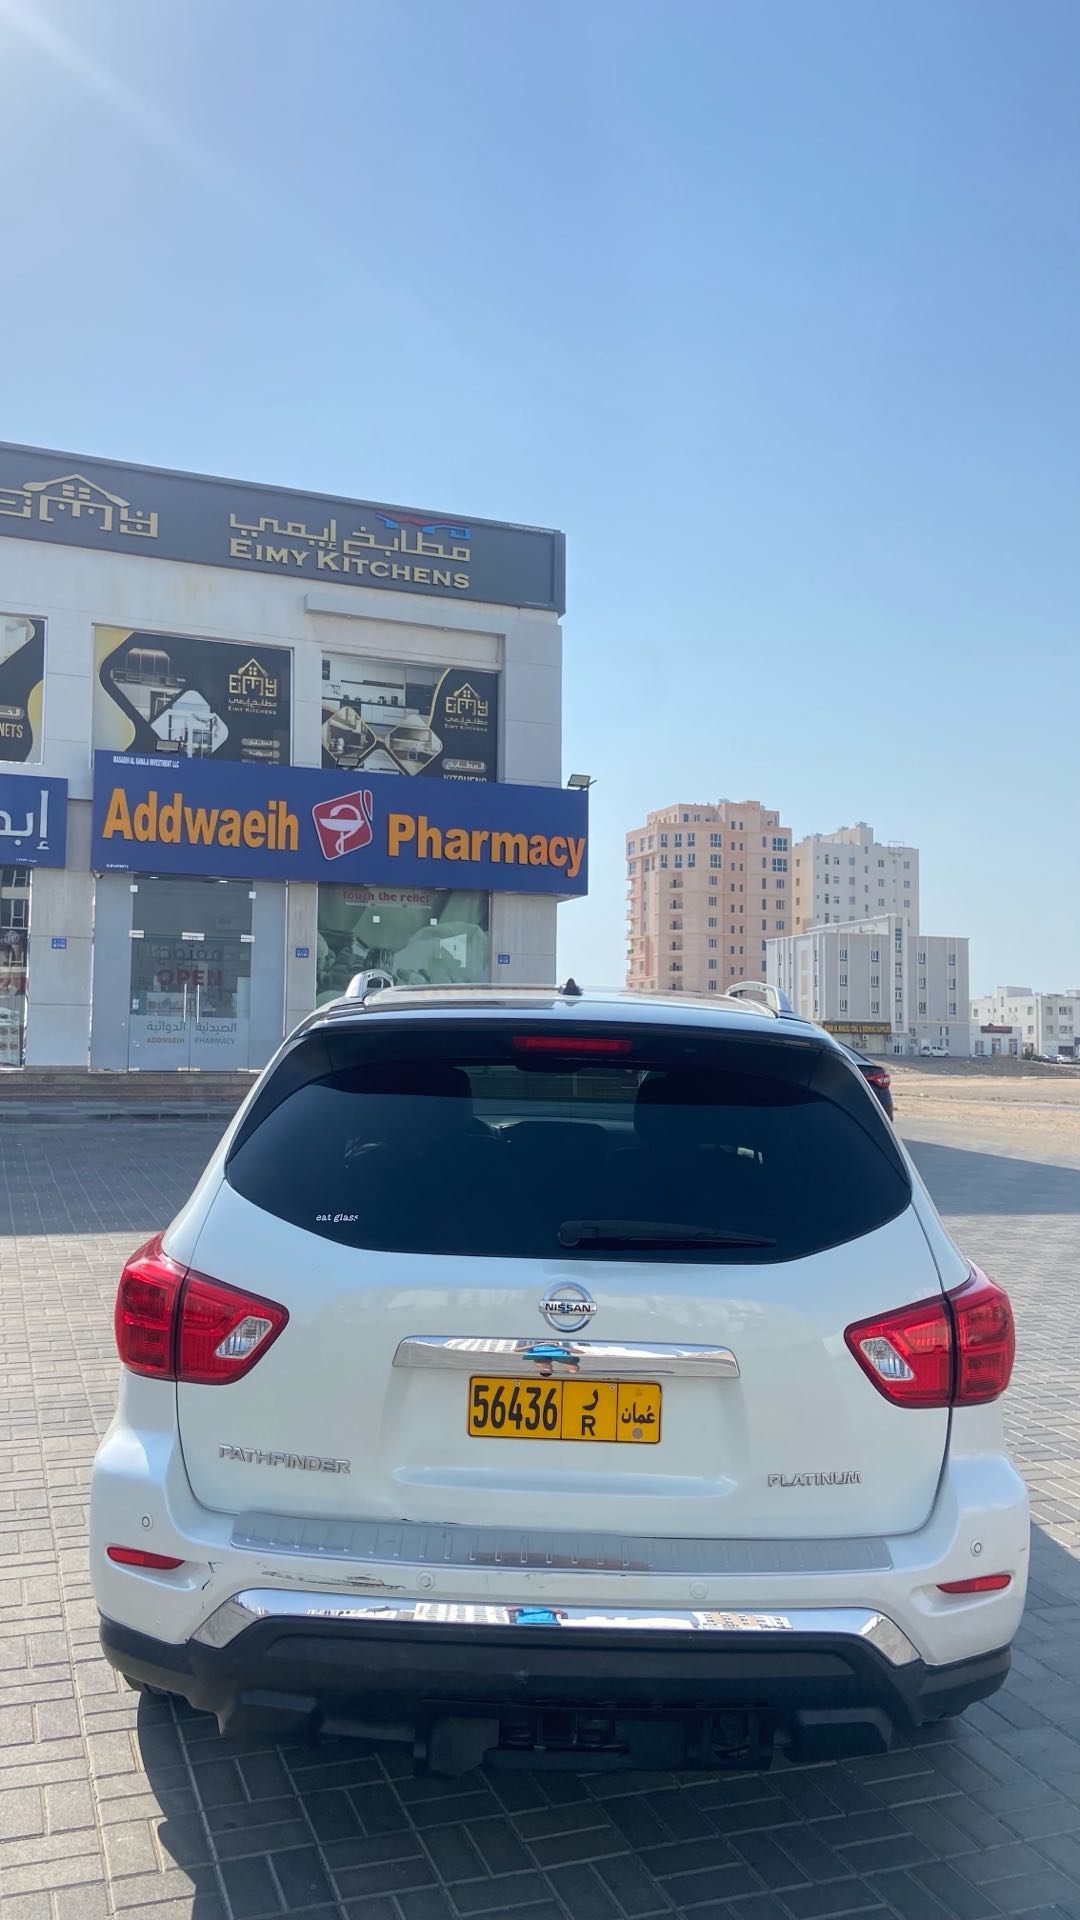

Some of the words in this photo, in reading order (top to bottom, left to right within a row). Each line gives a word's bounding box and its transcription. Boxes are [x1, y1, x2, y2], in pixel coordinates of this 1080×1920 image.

[343, 526, 470, 561] مطابخ
[317, 550, 470, 589] KITCHENS
[102, 787, 298, 851] Addwaeih
[387, 813, 586, 877] Pharmacy
[545, 1303, 592, 1313] NISSAN
[473, 1384, 558, 1430] 56436
[581, 1415, 596, 1436] R
[219, 1443, 351, 1474] PATHFINDER
[767, 1471, 861, 1487] PLATINUM
